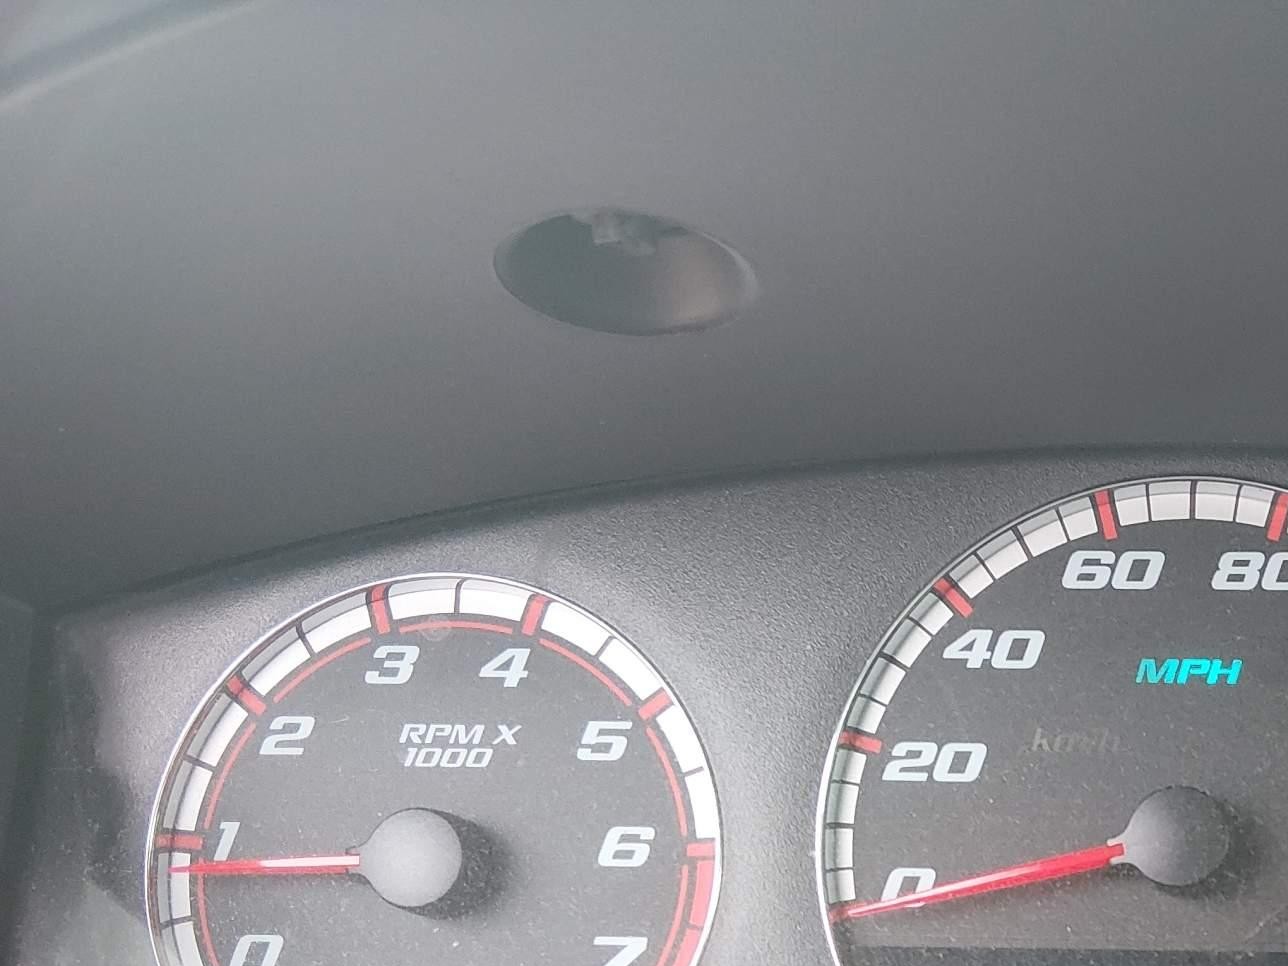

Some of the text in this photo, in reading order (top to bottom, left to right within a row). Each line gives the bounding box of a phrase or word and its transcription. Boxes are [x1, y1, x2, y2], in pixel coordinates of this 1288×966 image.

[1062, 551, 1166, 590] 60
[364, 645, 420, 685] 3
[478, 647, 529, 688] 4
[942, 629, 1046, 670] 40
[1136, 658, 1243, 686] MPH
[259, 715, 316, 755] 2
[399, 724, 522, 746] RPM X
[576, 720, 633, 762] 5
[403, 748, 493, 768] 1000
[881, 742, 987, 783] 20
[213, 821, 241, 861] 1
[597, 826, 656, 868] 6
[881, 867, 936, 907] 0
